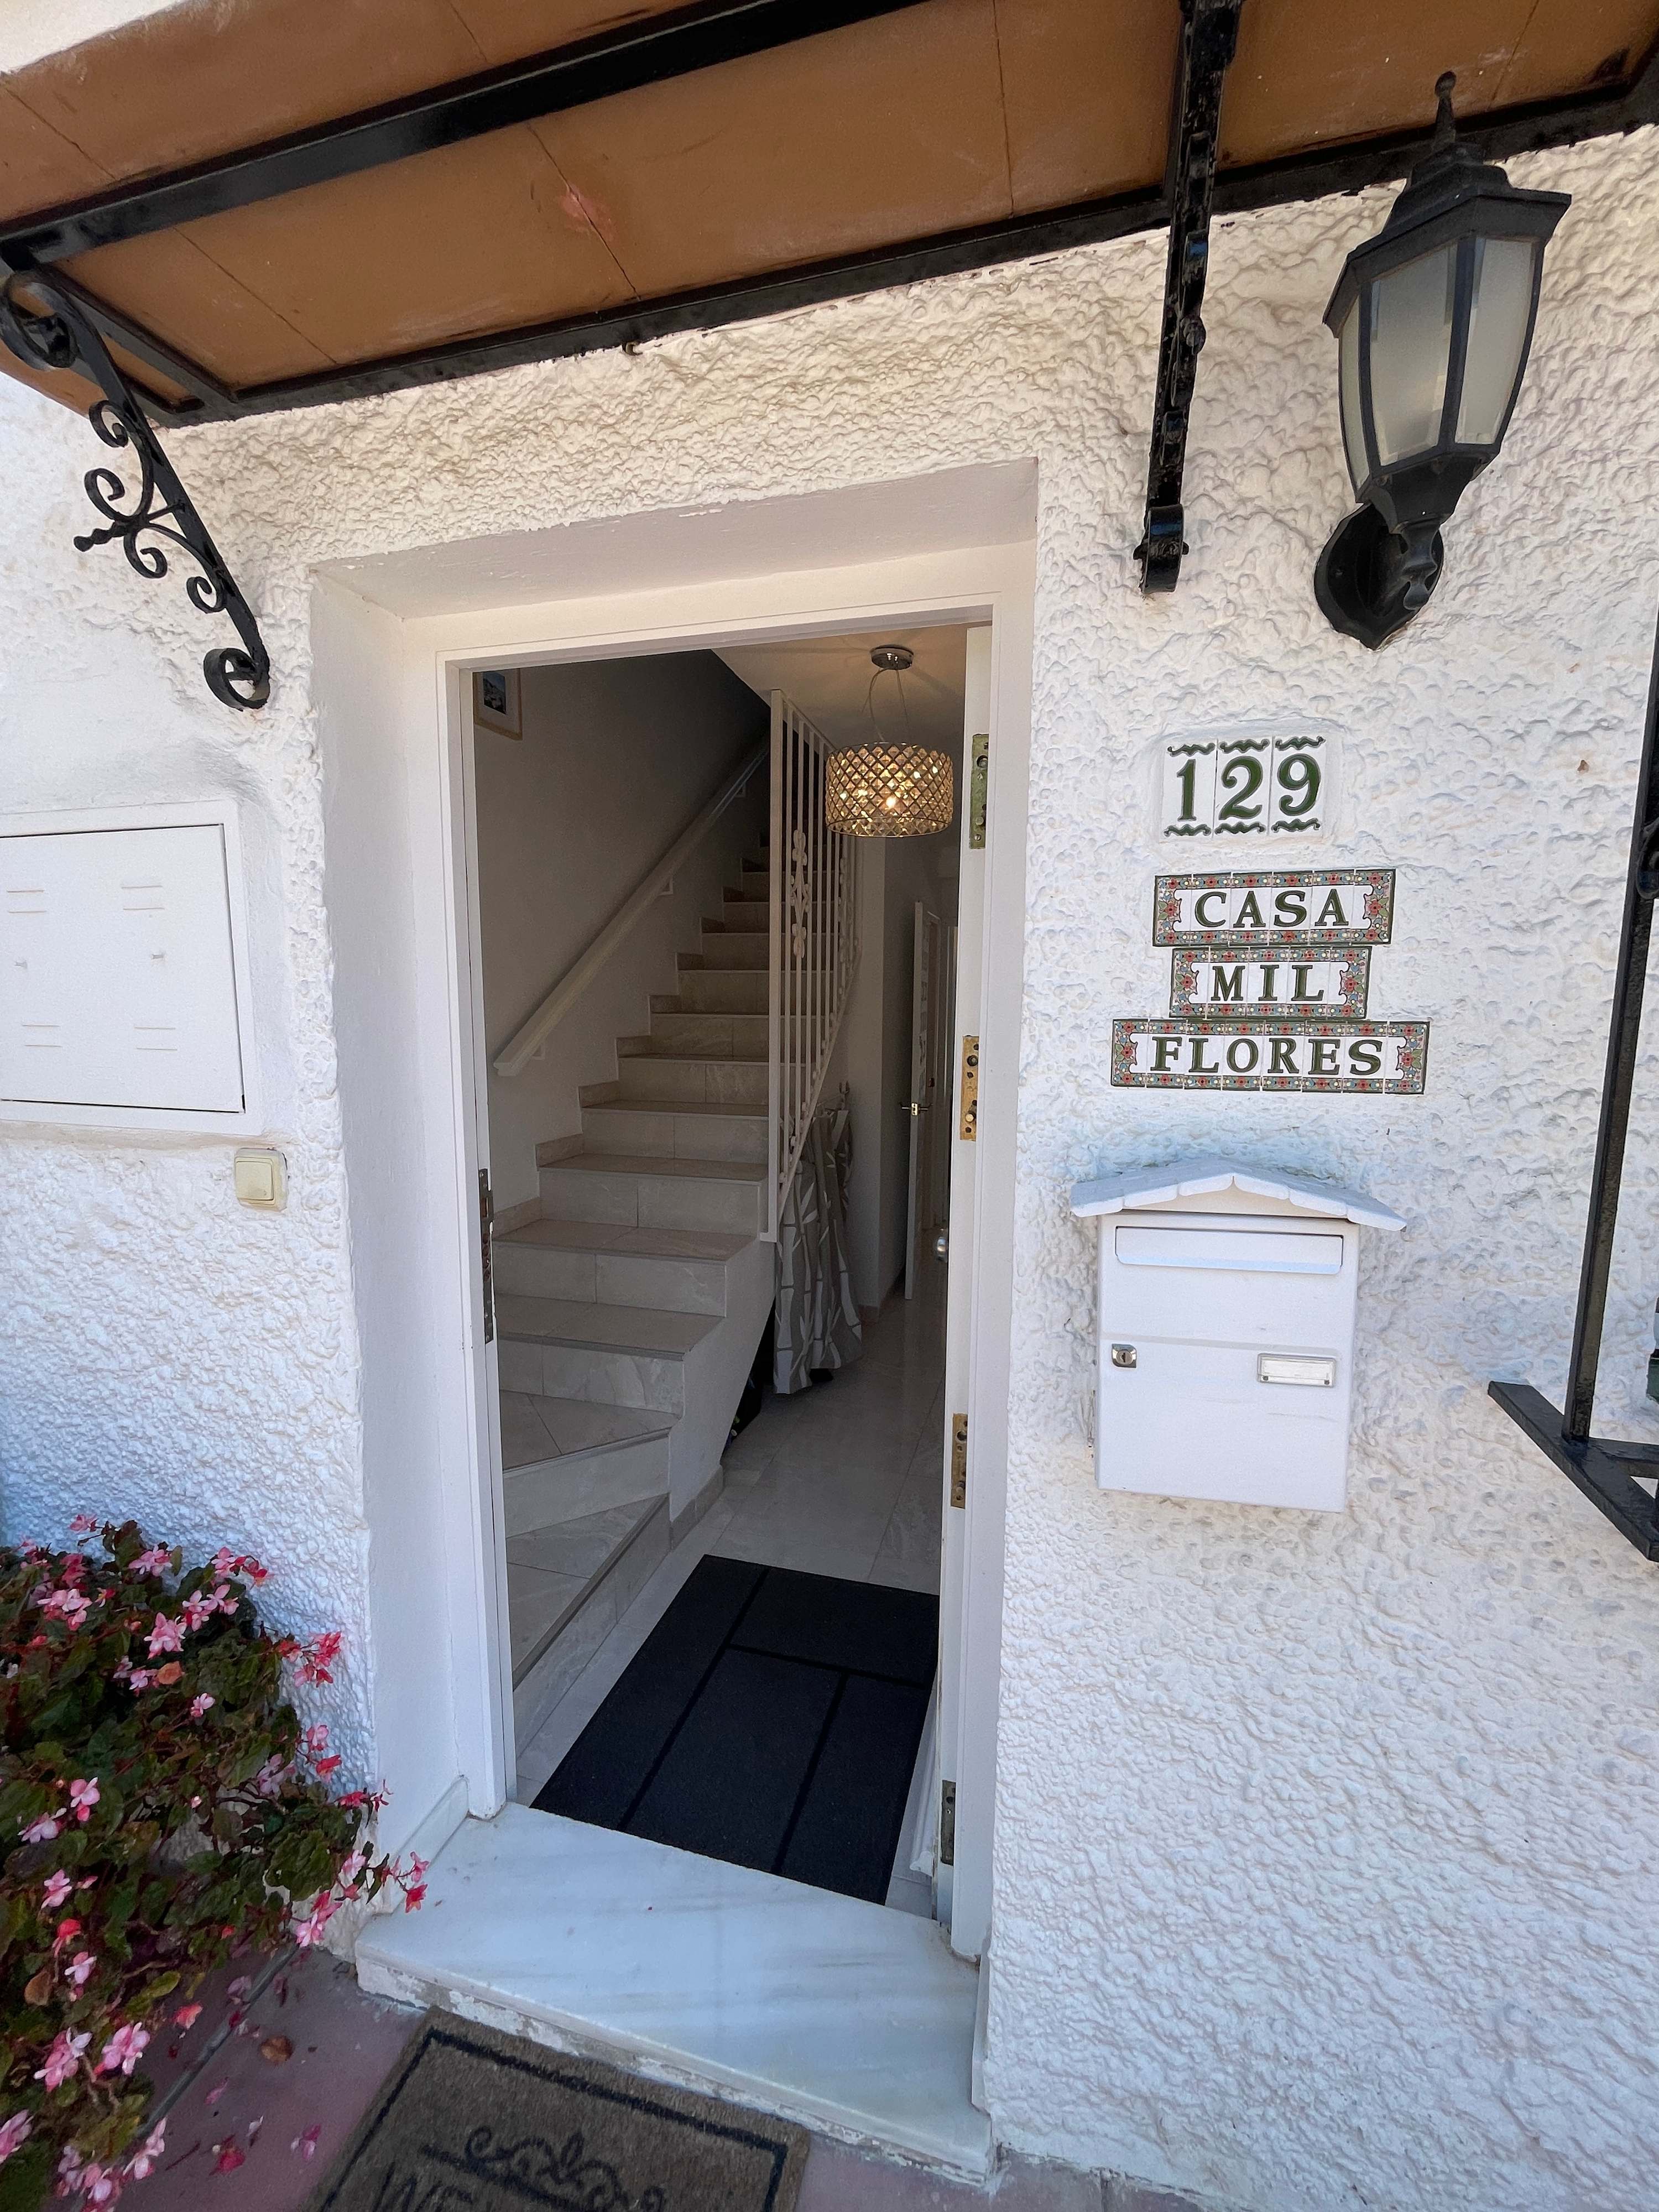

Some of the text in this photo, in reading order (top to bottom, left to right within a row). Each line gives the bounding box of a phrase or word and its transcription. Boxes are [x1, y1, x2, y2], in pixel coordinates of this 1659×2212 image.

[1176, 753, 1321, 821] 129
[1194, 889, 1349, 928] CASA
[1211, 964, 1324, 1001] MIL
[1150, 1036, 1383, 1076] FLORES
